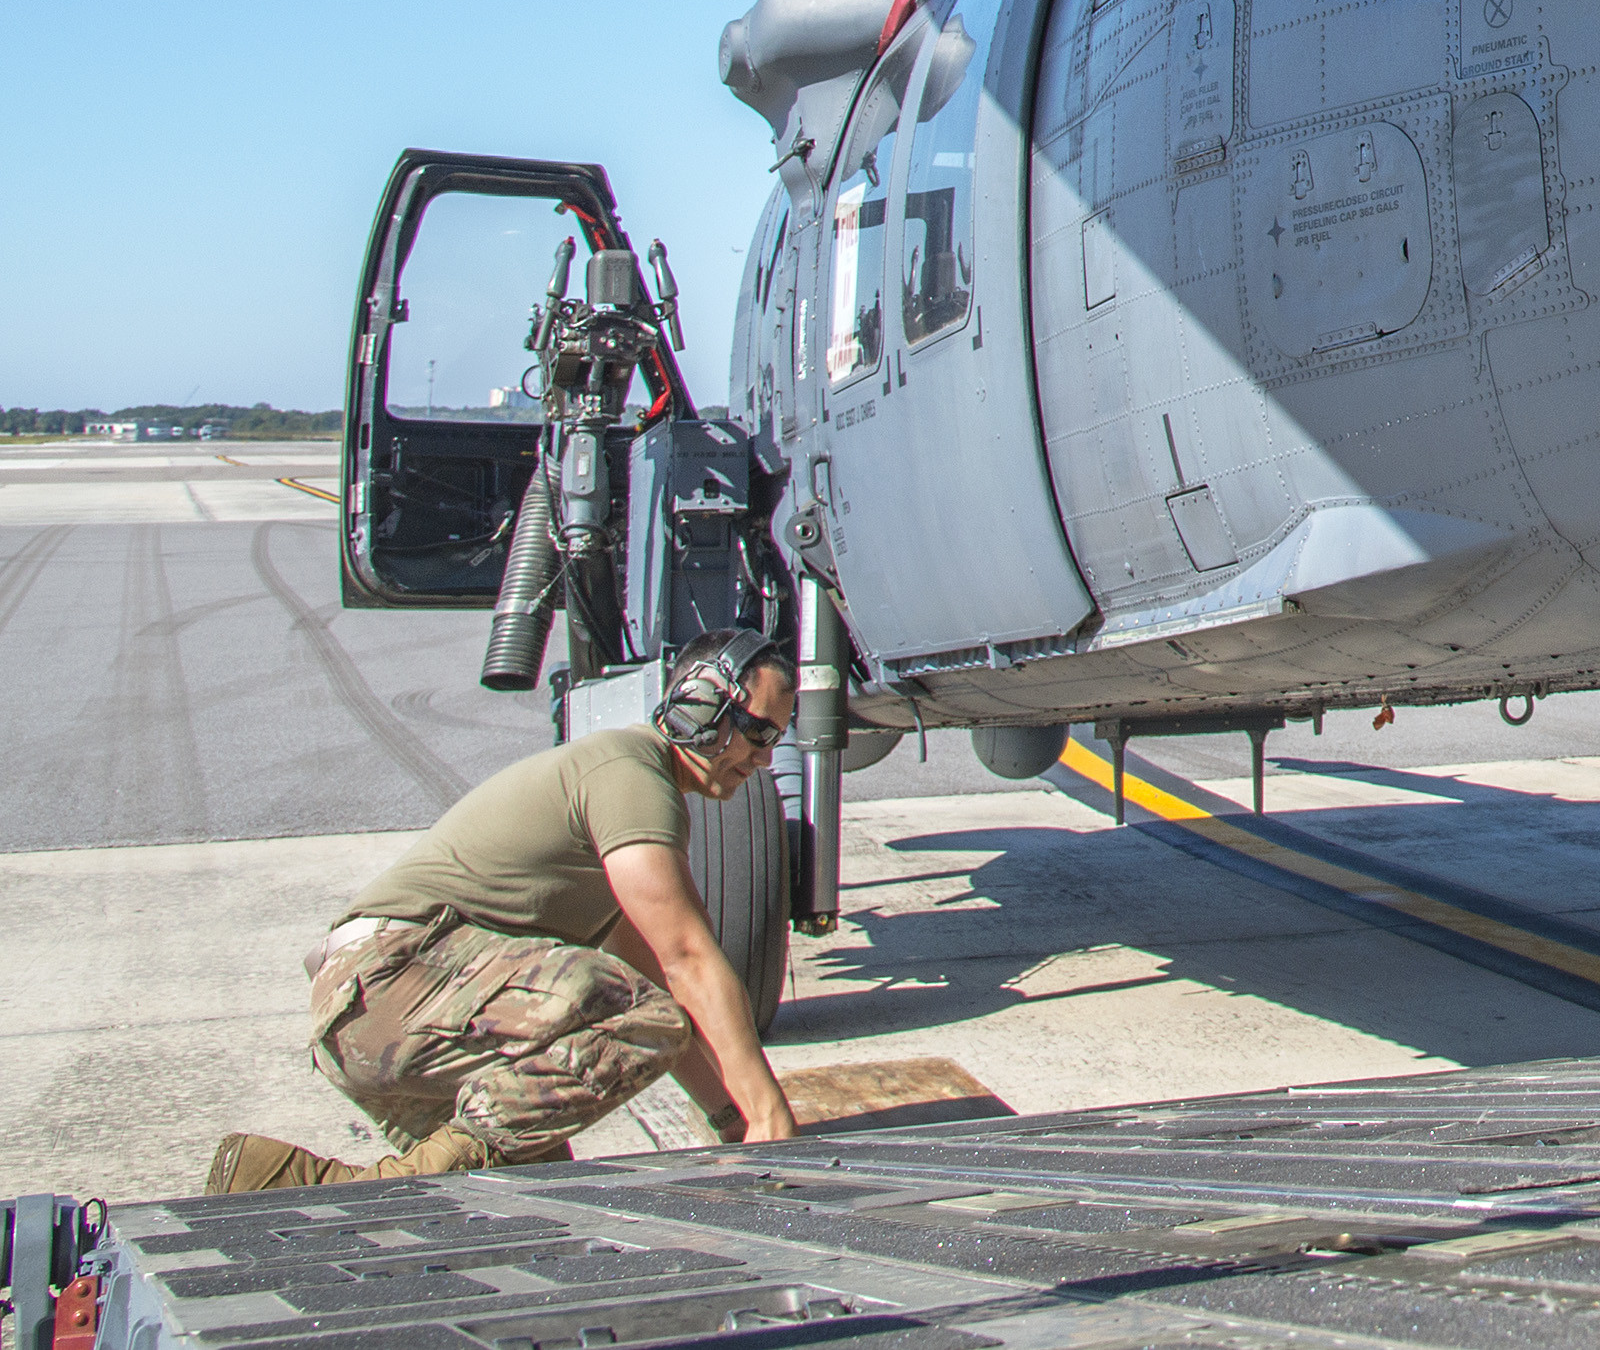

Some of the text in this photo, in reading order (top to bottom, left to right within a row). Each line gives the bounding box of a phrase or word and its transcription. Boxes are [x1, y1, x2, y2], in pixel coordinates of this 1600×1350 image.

[1472, 34, 1528, 55] PNEUMATIC
[1462, 50, 1535, 77] GROUND START
[1292, 184, 1405, 219] PRESSURE/CLOSED CIRCUIT
[1293, 215, 1337, 233] REFUELING
[1339, 211, 1358, 223] CAP
[1376, 199, 1400, 214] GALS
[1294, 230, 1332, 248] JP8 FUEL
